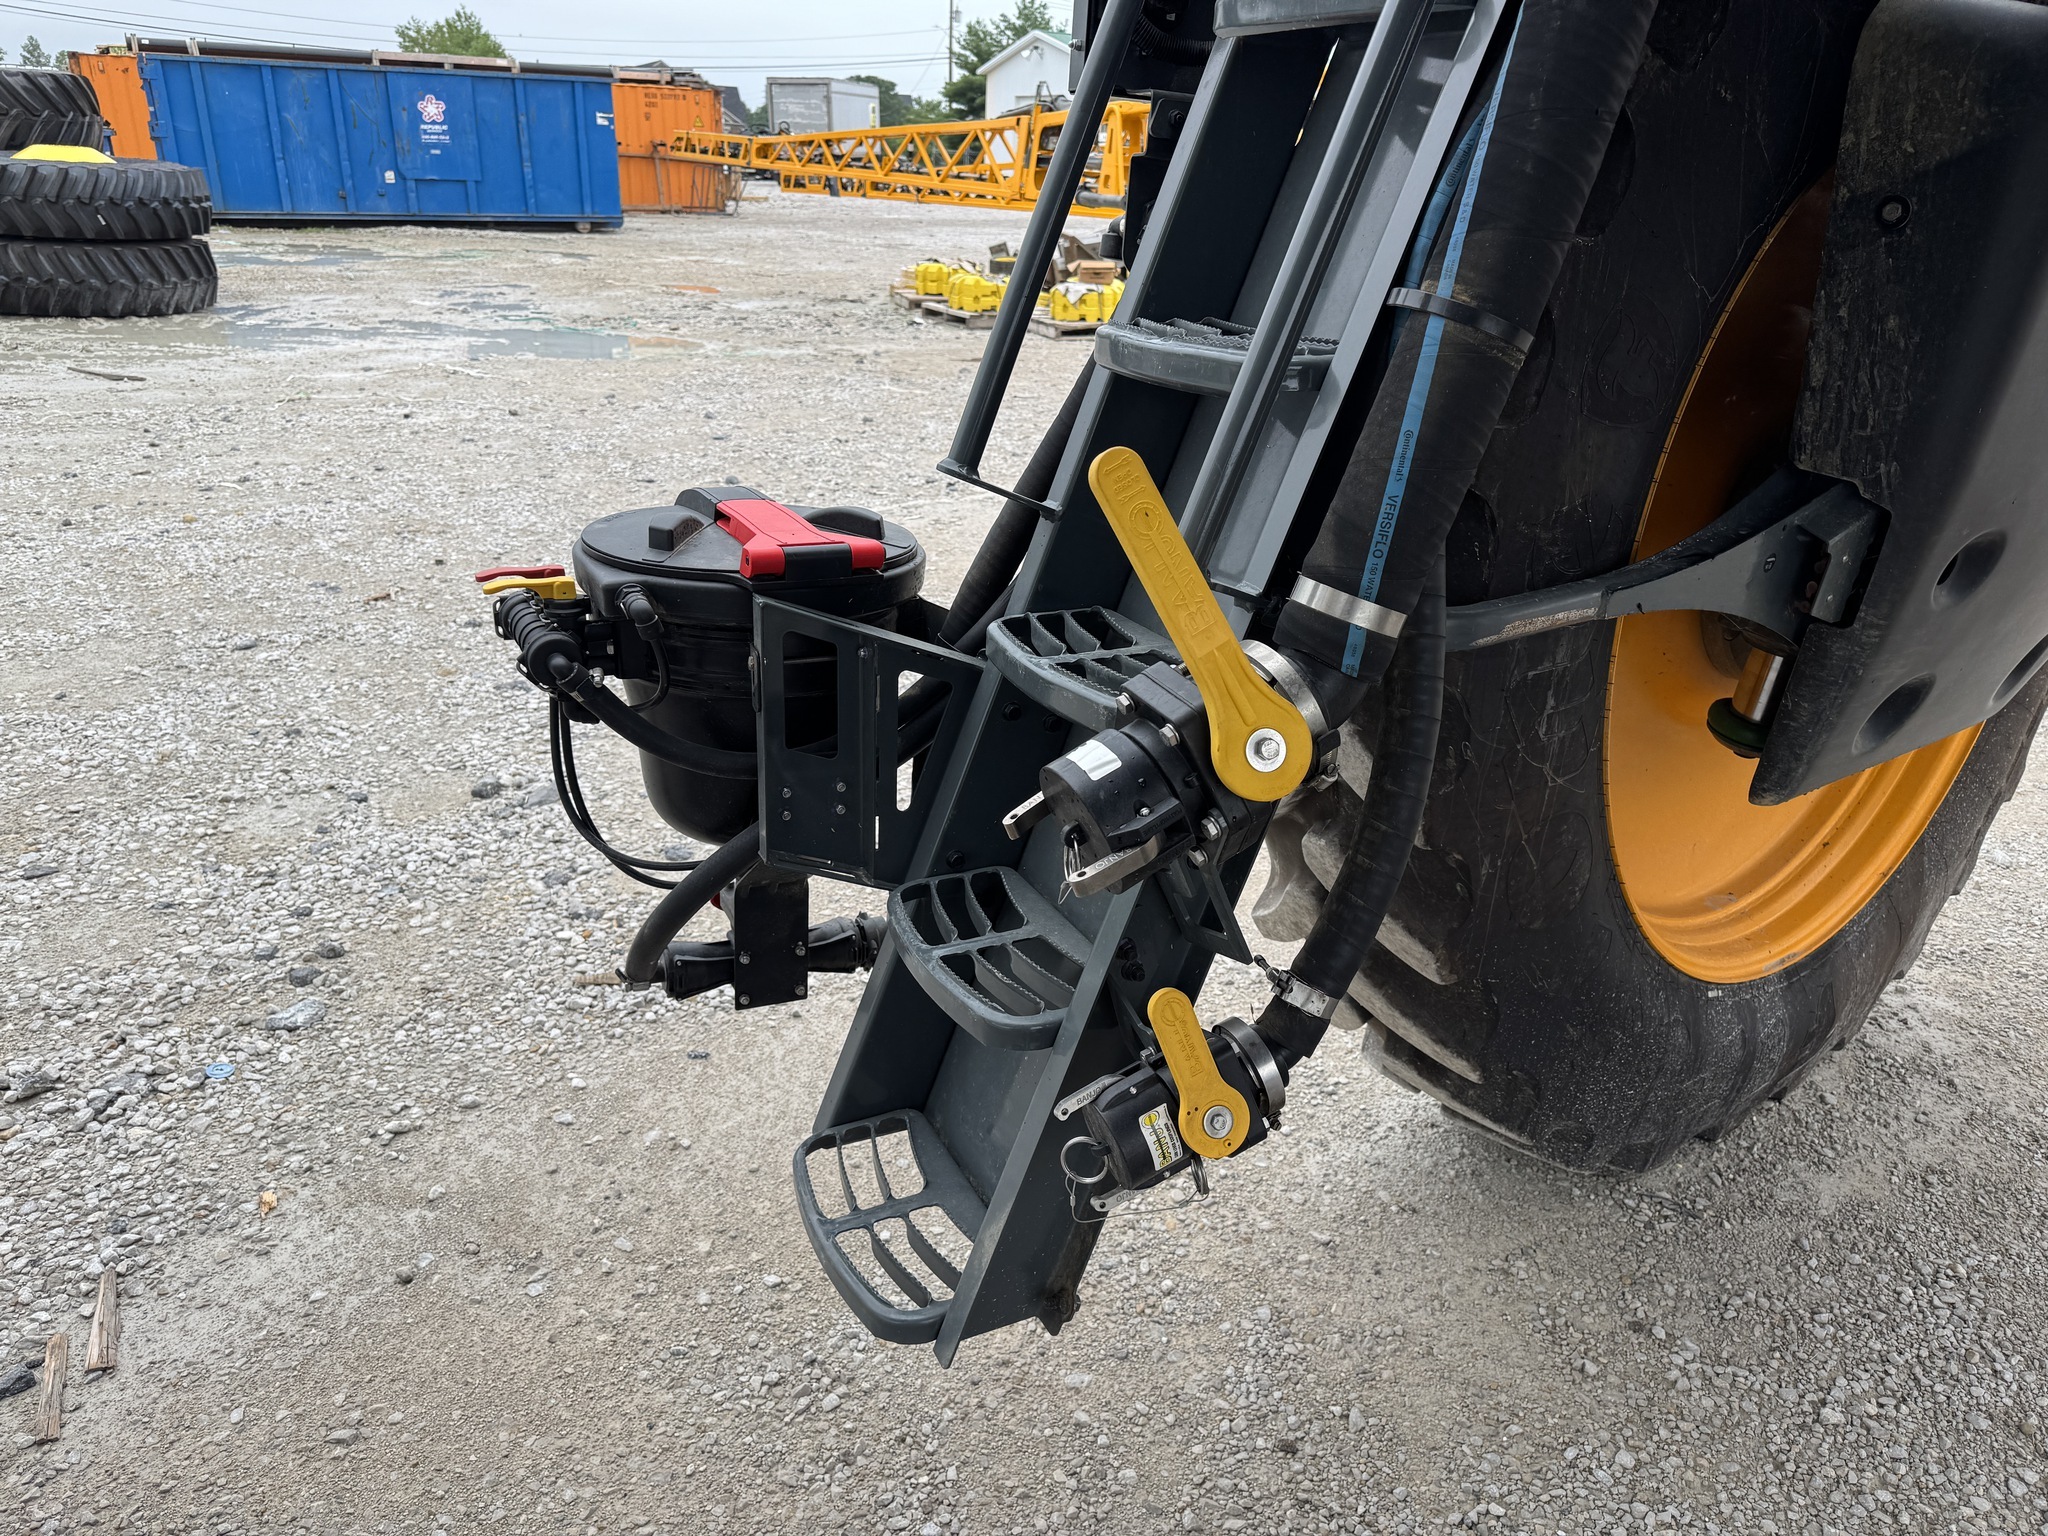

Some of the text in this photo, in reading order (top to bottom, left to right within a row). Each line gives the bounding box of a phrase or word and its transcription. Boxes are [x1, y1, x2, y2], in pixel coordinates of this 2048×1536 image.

[1446, 143, 1474, 187] Continental
[1466, 167, 1479, 200] WATER
[1396, 429, 1414, 477] Continental
[1112, 469, 1132, 485] OPEN
[1113, 474, 1140, 493] CLOSED
[1372, 494, 1399, 559] VERSIFLO
[1128, 501, 1216, 636] BANJO
[1370, 562, 1379, 577] 150
[1363, 577, 1377, 601] WATE
[1021, 795, 1044, 810] BAN
[1095, 849, 1132, 869] BANJO
[1076, 1086, 1101, 1106] BANJO
[1141, 1110, 1173, 1167] BANJO
[1114, 1187, 1136, 1203] ANJO
